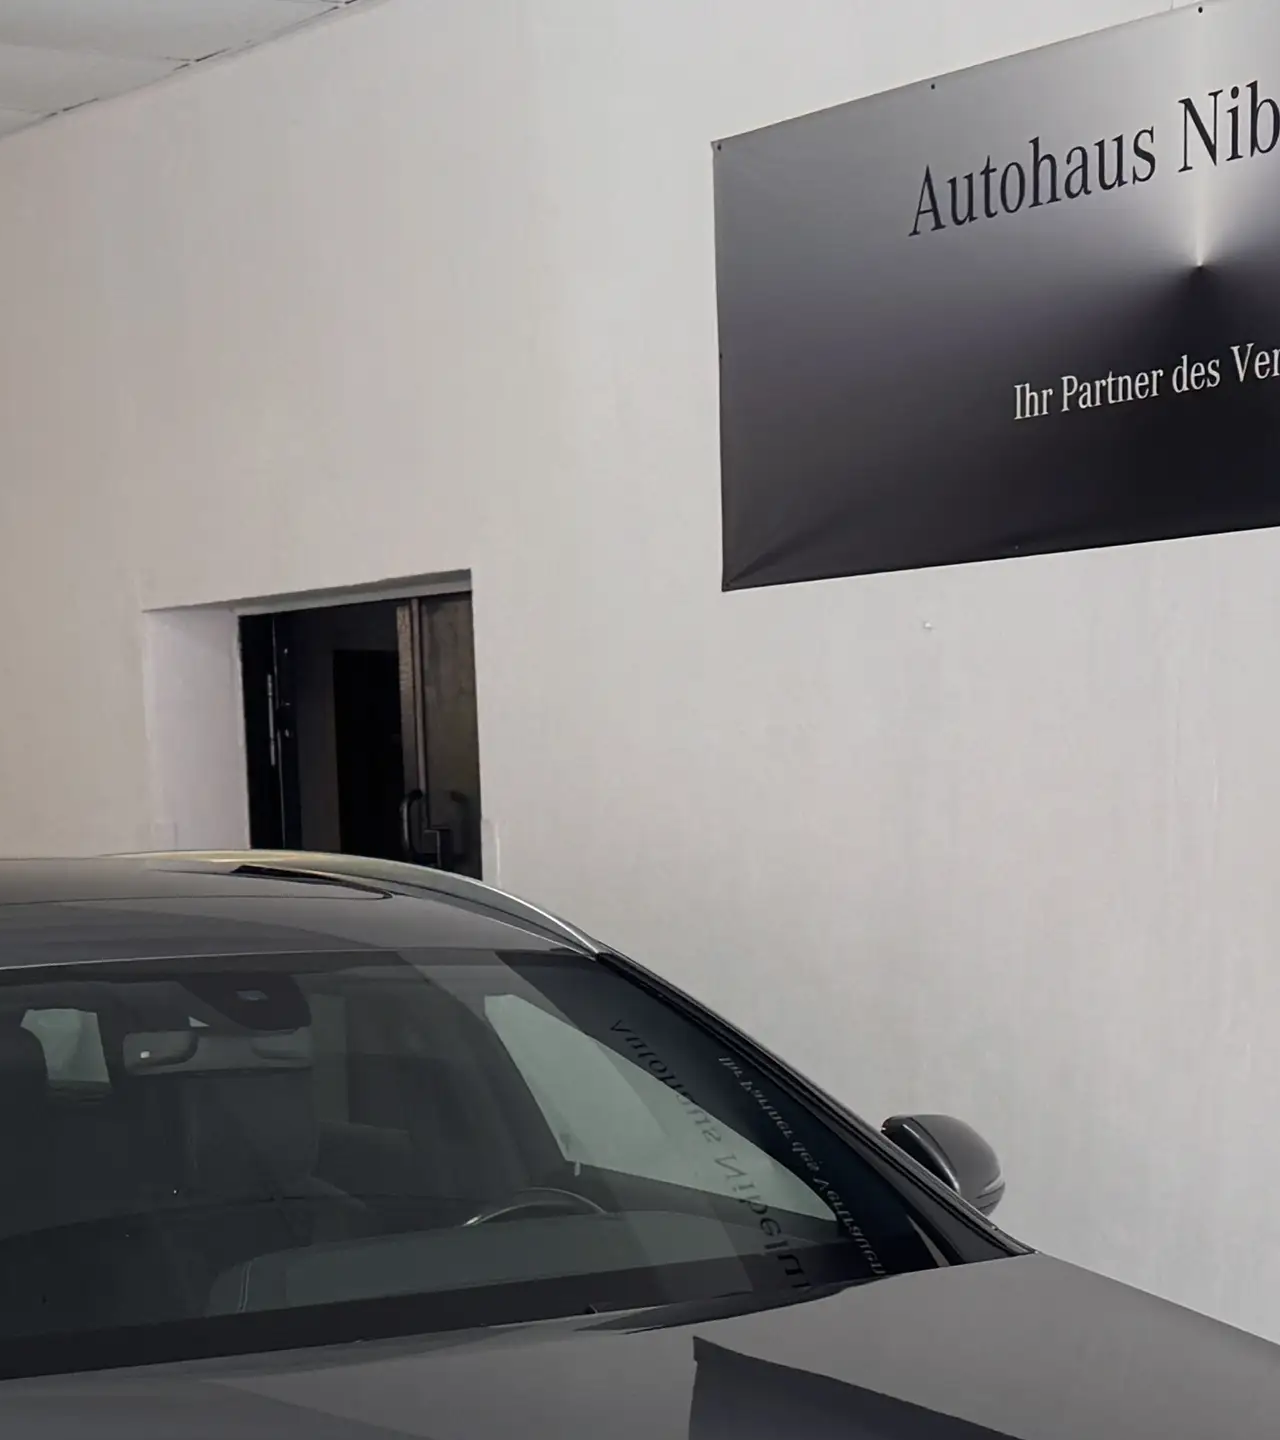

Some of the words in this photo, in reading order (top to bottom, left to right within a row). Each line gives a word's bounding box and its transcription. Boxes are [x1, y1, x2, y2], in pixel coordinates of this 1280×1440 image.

[909, 124, 1157, 237] Autohaus
[1013, 382, 1055, 420] Ihr
[1060, 367, 1165, 413] Partner
[1171, 354, 1222, 394] des
